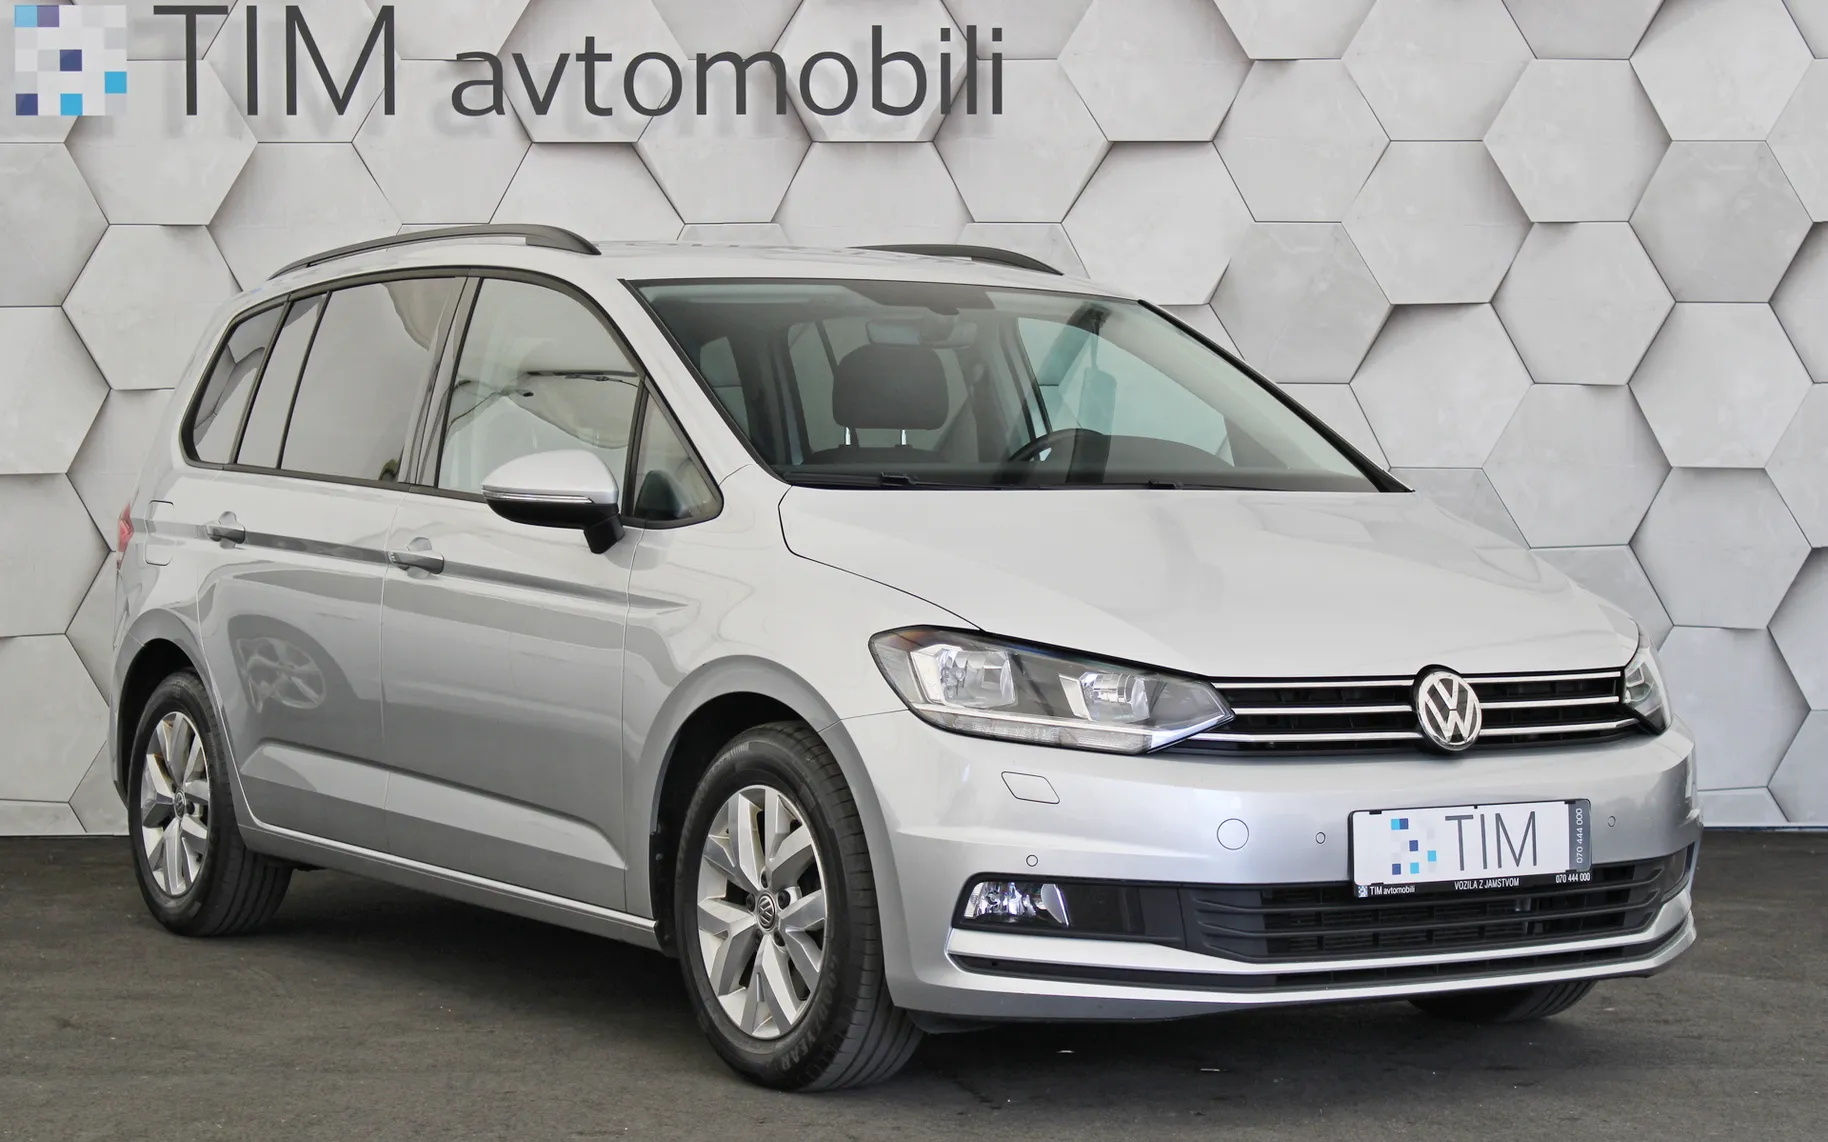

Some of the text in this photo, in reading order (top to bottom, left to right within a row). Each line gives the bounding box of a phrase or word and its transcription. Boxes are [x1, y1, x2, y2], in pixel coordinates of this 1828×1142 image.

[153, 5, 1002, 116] TIM avtomobili
[1445, 811, 1537, 871] TIM
[1575, 808, 1584, 864] 070 444 000
[1370, 885, 1415, 895] TIM avtomobili
[1454, 877, 1520, 890] VOZILA Z JAMSTVOM
[1555, 872, 1591, 883] 070 444 000
[781, 955, 840, 1072] GOODYEAR
